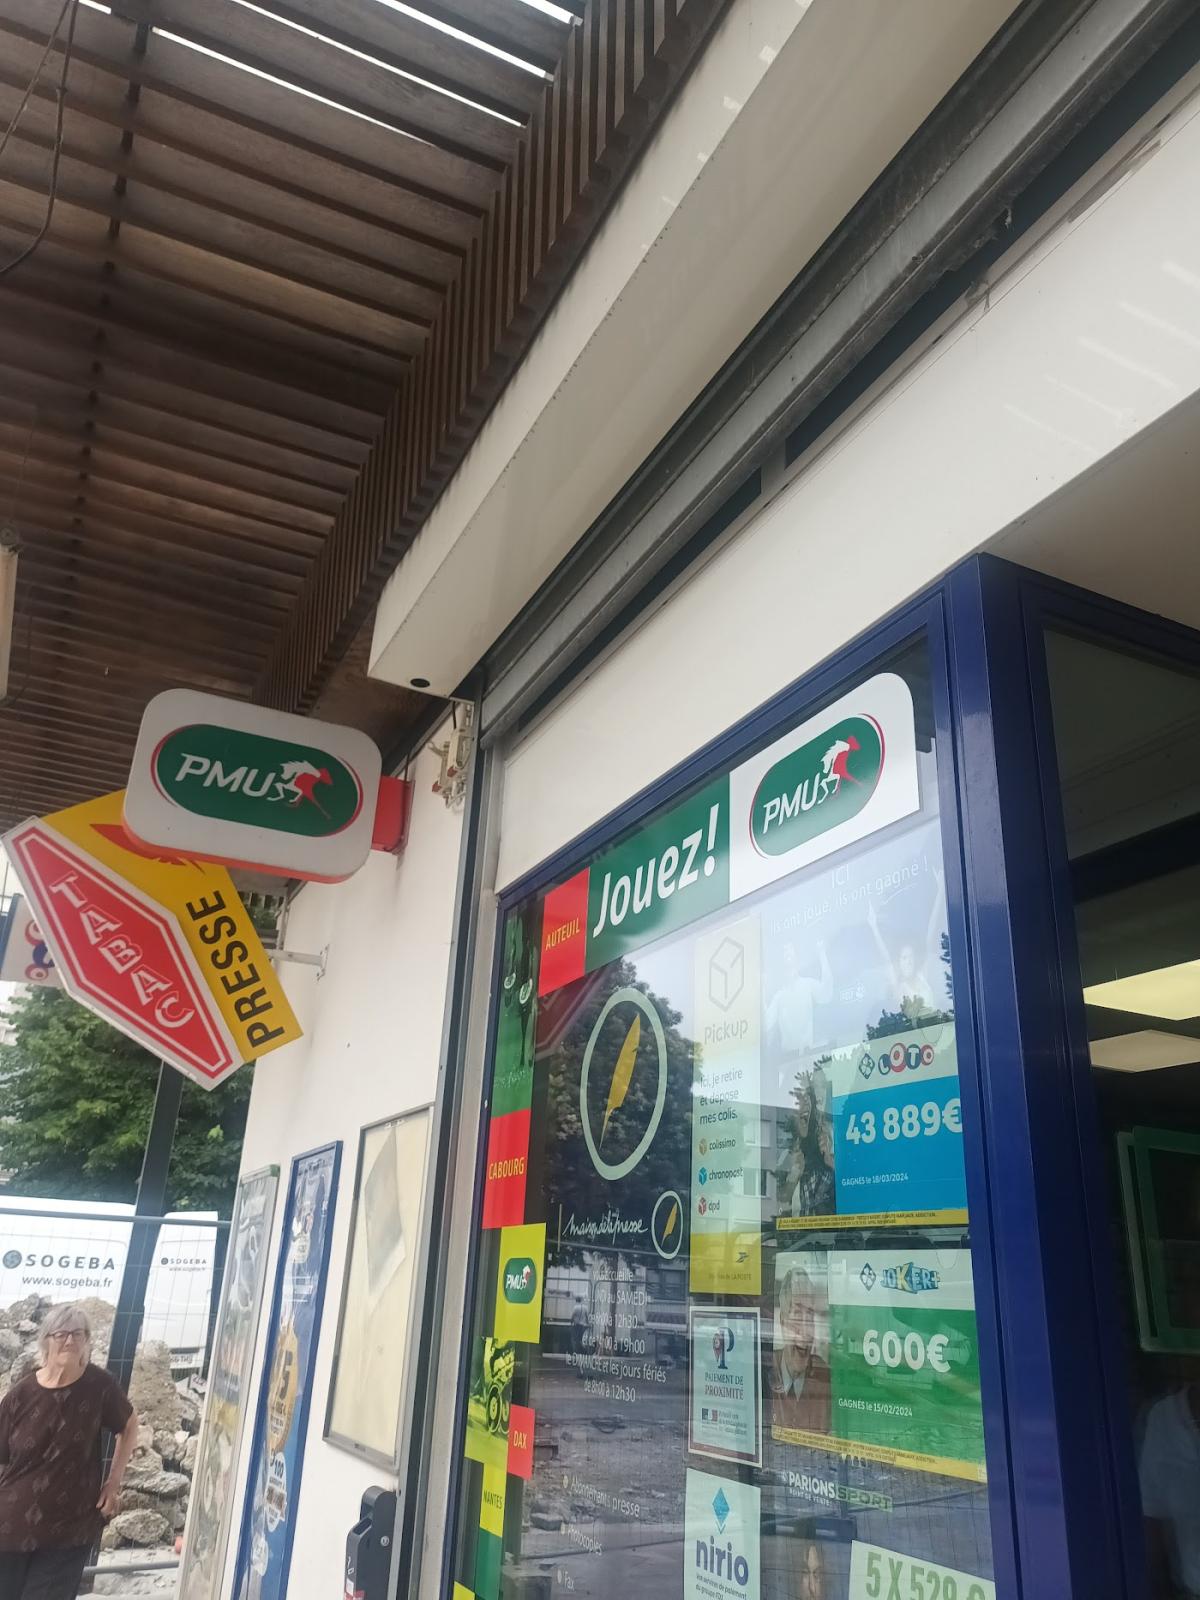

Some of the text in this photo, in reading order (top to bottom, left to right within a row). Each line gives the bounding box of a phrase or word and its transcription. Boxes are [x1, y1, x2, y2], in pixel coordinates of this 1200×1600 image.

[175, 752, 275, 798] PMU
[762, 773, 821, 834] PMU
[593, 803, 720, 937] Jouez!
[831, 864, 849, 888] ICI
[851, 882, 873, 900] ont
[875, 862, 919, 895] gagné
[545, 917, 581, 951] AUTEUIL
[51, 871, 194, 1028] TABAC
[185, 889, 285, 1048] PRESSE
[704, 1018, 749, 1045] Pickup
[878, 1042, 934, 1075] LOTO
[721, 1068, 742, 1082] retire
[700, 1112, 717, 1125] mes
[845, 1098, 963, 1145] 43 889€
[709, 1138, 736, 1150] colissimo
[488, 1156, 525, 1180] CABOURG
[709, 1167, 743, 1180] chronopost
[708, 1200, 720, 1213] dpd
[25, 1253, 115, 1271] SOGEBA
[22, 1275, 113, 1289] www.sogeba.fr
[505, 1273, 523, 1290] PMU
[880, 1262, 940, 1294] JOKER+
[620, 1337, 645, 1354] 19h00
[862, 1329, 951, 1373] 600€
[609, 1361, 619, 1376] les
[620, 1361, 641, 1379] jours
[643, 1363, 666, 1383] fériés
[705, 1371, 743, 1385] PAIEMENT DE
[612, 1384, 636, 1402] 12h30
[866, 1401, 873, 1411] le
[873, 1403, 912, 1417] 15/02/2024
[513, 1430, 527, 1449] DAX
[483, 1489, 503, 1510] NANTES
[789, 1471, 890, 1510] PARIONS SPORT
[612, 1496, 640, 1518] presse
[696, 1535, 749, 1586] nirio
[564, 1570, 575, 1590] Fax
[866, 1551, 881, 1598] 5
[887, 1557, 903, 1600] X
